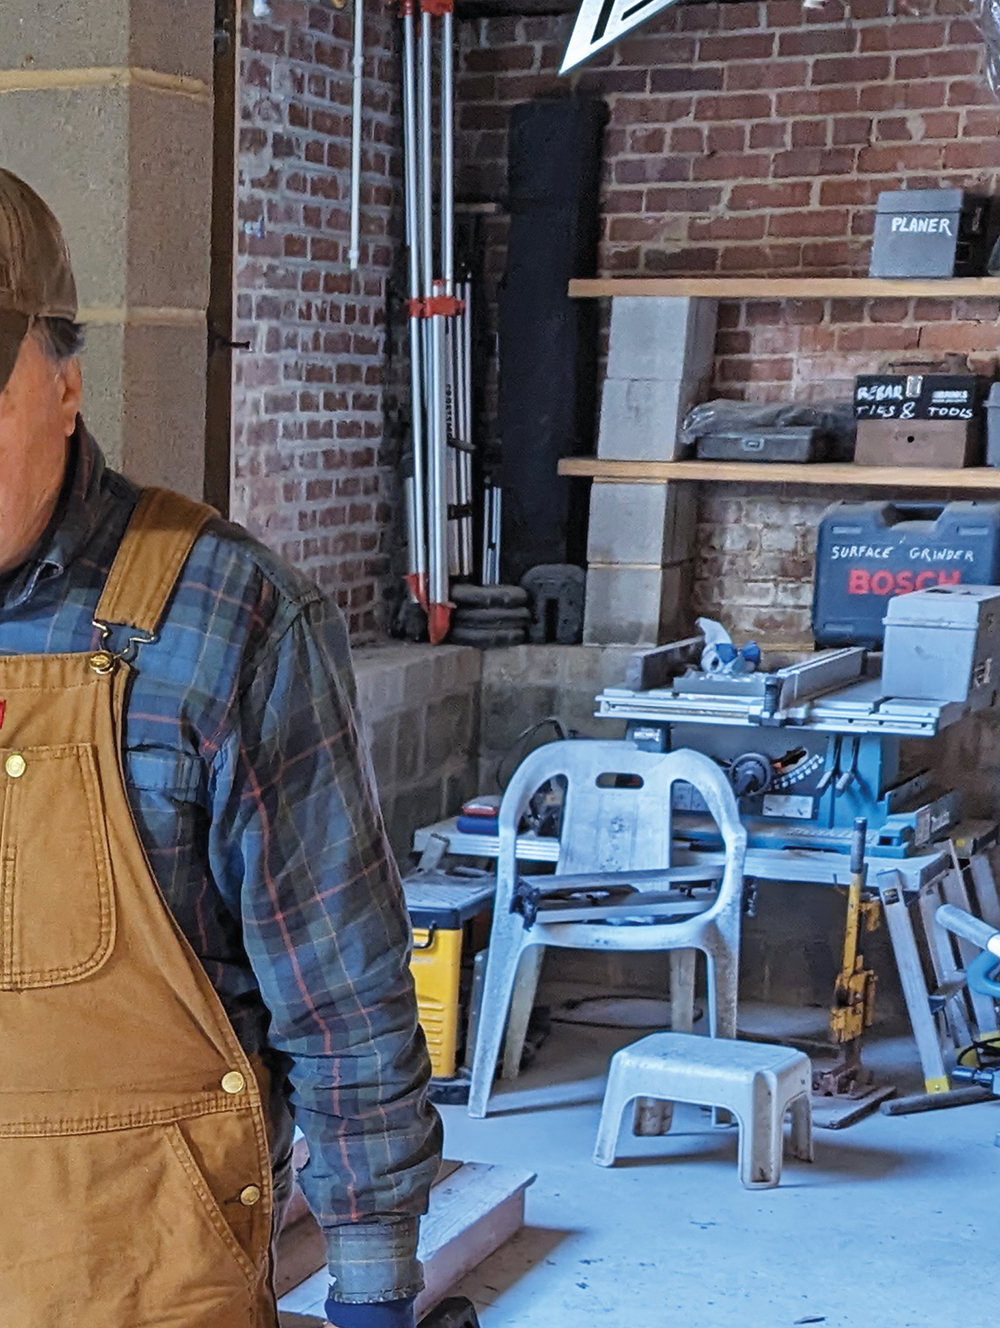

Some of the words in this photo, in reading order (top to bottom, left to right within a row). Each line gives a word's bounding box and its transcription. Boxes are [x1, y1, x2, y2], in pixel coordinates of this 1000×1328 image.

[891, 217, 952, 236] PLANER
[857, 385, 903, 401] REBAR
[856, 405, 895, 418] TIES
[900, 401, 916, 419] &
[928, 406, 973, 419] TOOLS
[831, 545, 894, 560] SURFACE
[909, 547, 974, 562] GRINDER
